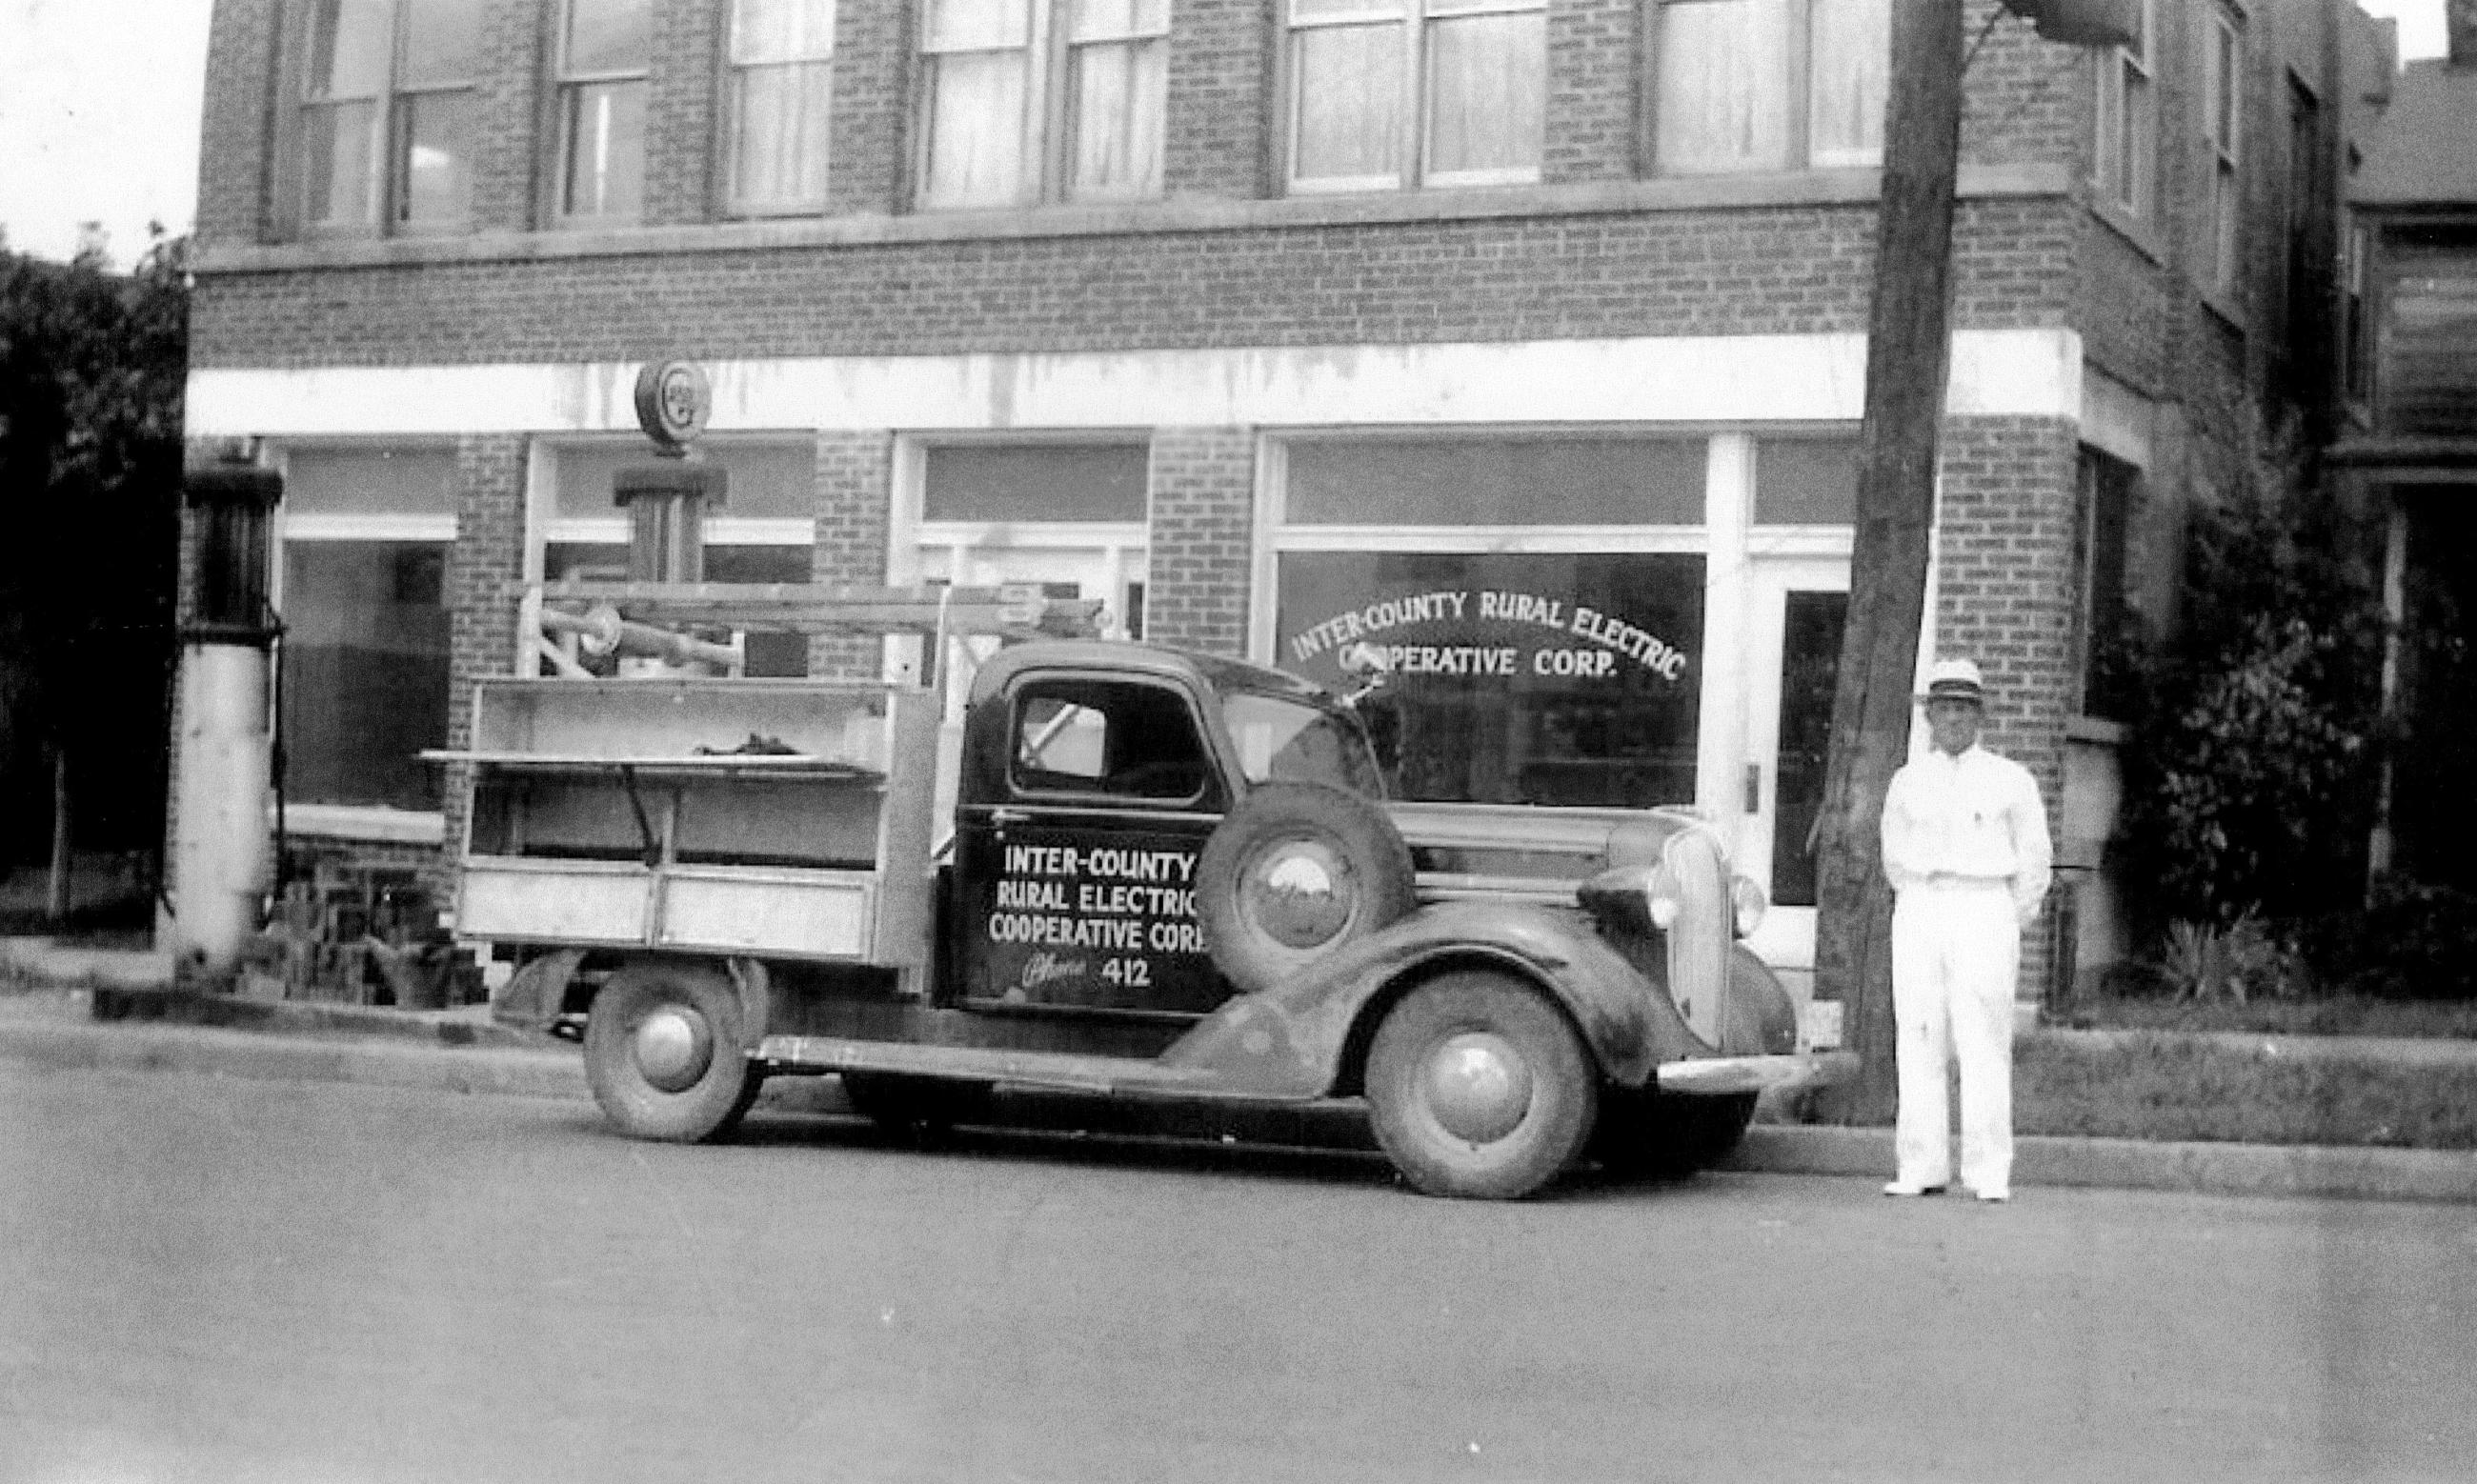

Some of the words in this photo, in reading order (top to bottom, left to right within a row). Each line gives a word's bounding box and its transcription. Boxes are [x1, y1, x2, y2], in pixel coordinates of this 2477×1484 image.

[1291, 592, 1467, 662] INTER-COUNTY
[1480, 591, 1564, 629] RURAL
[1571, 607, 1685, 680] ELECTRIC
[1339, 644, 1517, 674] CPERATIVE
[1535, 649, 1618, 676] CORP.
[1005, 844, 1197, 881] INTER-COUNTY
[997, 880, 1069, 910] RURAL
[1079, 884, 1197, 916] ELECTRIC
[989, 912, 1142, 949] COOPERATIVE
[1102, 957, 1150, 987] 412
